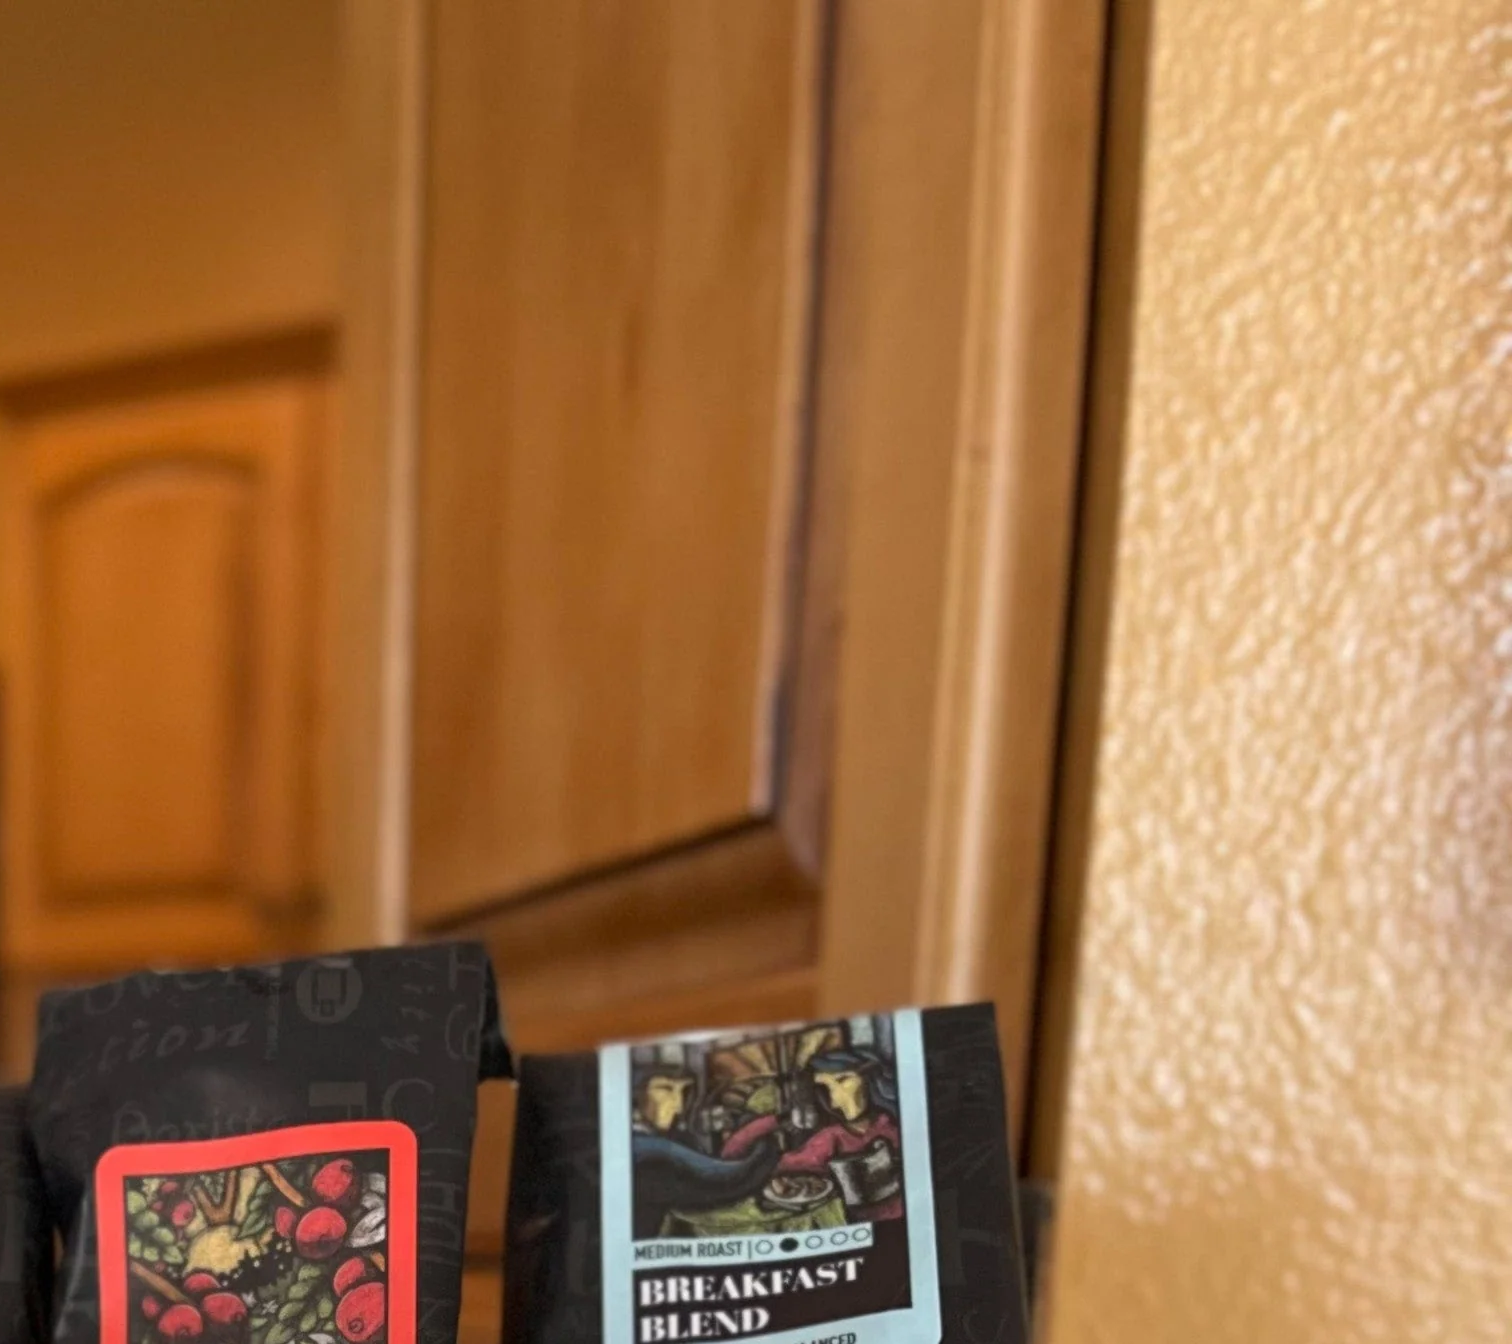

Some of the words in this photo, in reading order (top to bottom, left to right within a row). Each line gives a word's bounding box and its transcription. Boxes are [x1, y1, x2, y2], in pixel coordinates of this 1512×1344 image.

[634, 1243, 691, 1261] MEDIUM
[697, 1240, 743, 1259] ROAST
[640, 1257, 864, 1306] BREAKFAST
[640, 1306, 770, 1344] BLEND
